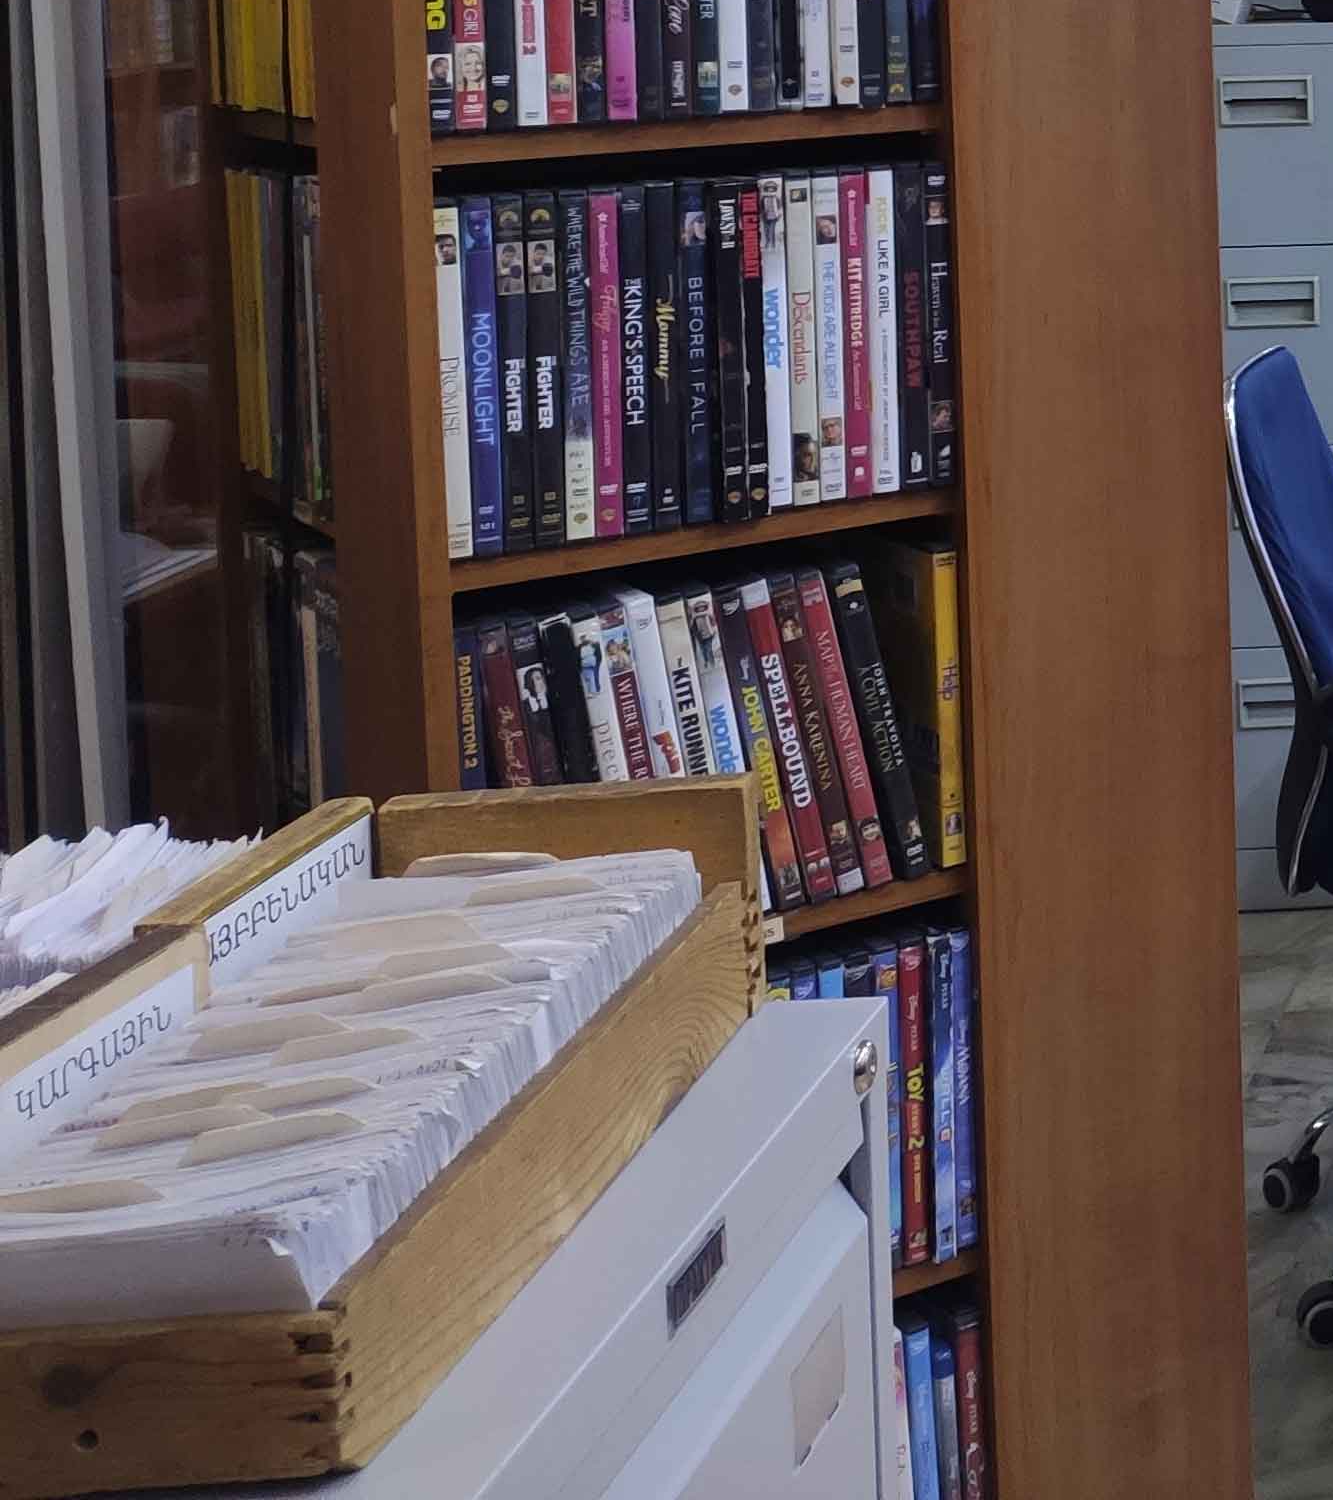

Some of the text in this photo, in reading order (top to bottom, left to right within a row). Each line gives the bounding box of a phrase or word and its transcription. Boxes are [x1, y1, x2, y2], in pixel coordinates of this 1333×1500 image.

[463, 8, 479, 37] GIRL
[565, 206, 583, 248] WHERE
[740, 190, 760, 279] THE CANDIDATE
[877, 239, 890, 272] LIKE
[566, 276, 587, 307] WILD
[823, 260, 835, 284] THE
[847, 258, 863, 282] KIT
[878, 274, 890, 284] A
[622, 284, 644, 351] KING'S
[687, 276, 704, 361] BEFORE
[823, 284, 836, 314] KIDS
[824, 314, 836, 340] ARE
[848, 283, 864, 348] KITTREDGE
[878, 286, 893, 318] GIRL
[568, 310, 590, 367] THINGS
[655, 298, 676, 383] Mommy
[764, 287, 784, 369] wonder
[825, 340, 837, 363] ALL
[903, 270, 923, 389] SOUTHPAW
[931, 329, 949, 364] Real
[440, 356, 462, 438] PROMISE
[471, 312, 495, 446] MOONLIGHT
[503, 359, 523, 433] FIGHTER
[535, 355, 555, 430] FIGHTER
[570, 373, 590, 406] ARE
[624, 353, 646, 425] SPEECH
[690, 381, 705, 435] FALL
[814, 629, 835, 668] MAP
[457, 655, 479, 770] PADDINGTON 2
[615, 678, 641, 731] WHERE
[671, 667, 696, 713] KITE
[740, 685, 766, 734] JOHN
[791, 662, 815, 707] ANNA
[827, 681, 858, 741] HUMAN
[588, 719, 621, 780] prec
[625, 732, 646, 767] THE
[680, 714, 709, 776] RUNN
[709, 703, 741, 773] wonde
[758, 653, 813, 810] SPELLBOUND
[801, 710, 832, 793] KARENINA
[858, 676, 880, 715] CIVIL
[869, 719, 896, 774] ACTION
[752, 737, 783, 814] CARTER
[840, 741, 867, 792] HEART
[15, 1004, 172, 1120] ԿԱՐԳԱՅԻՆ
[906, 1062, 924, 1102] TOY
[956, 1045, 970, 1106] MOANA
[908, 1136, 924, 1151] 2
